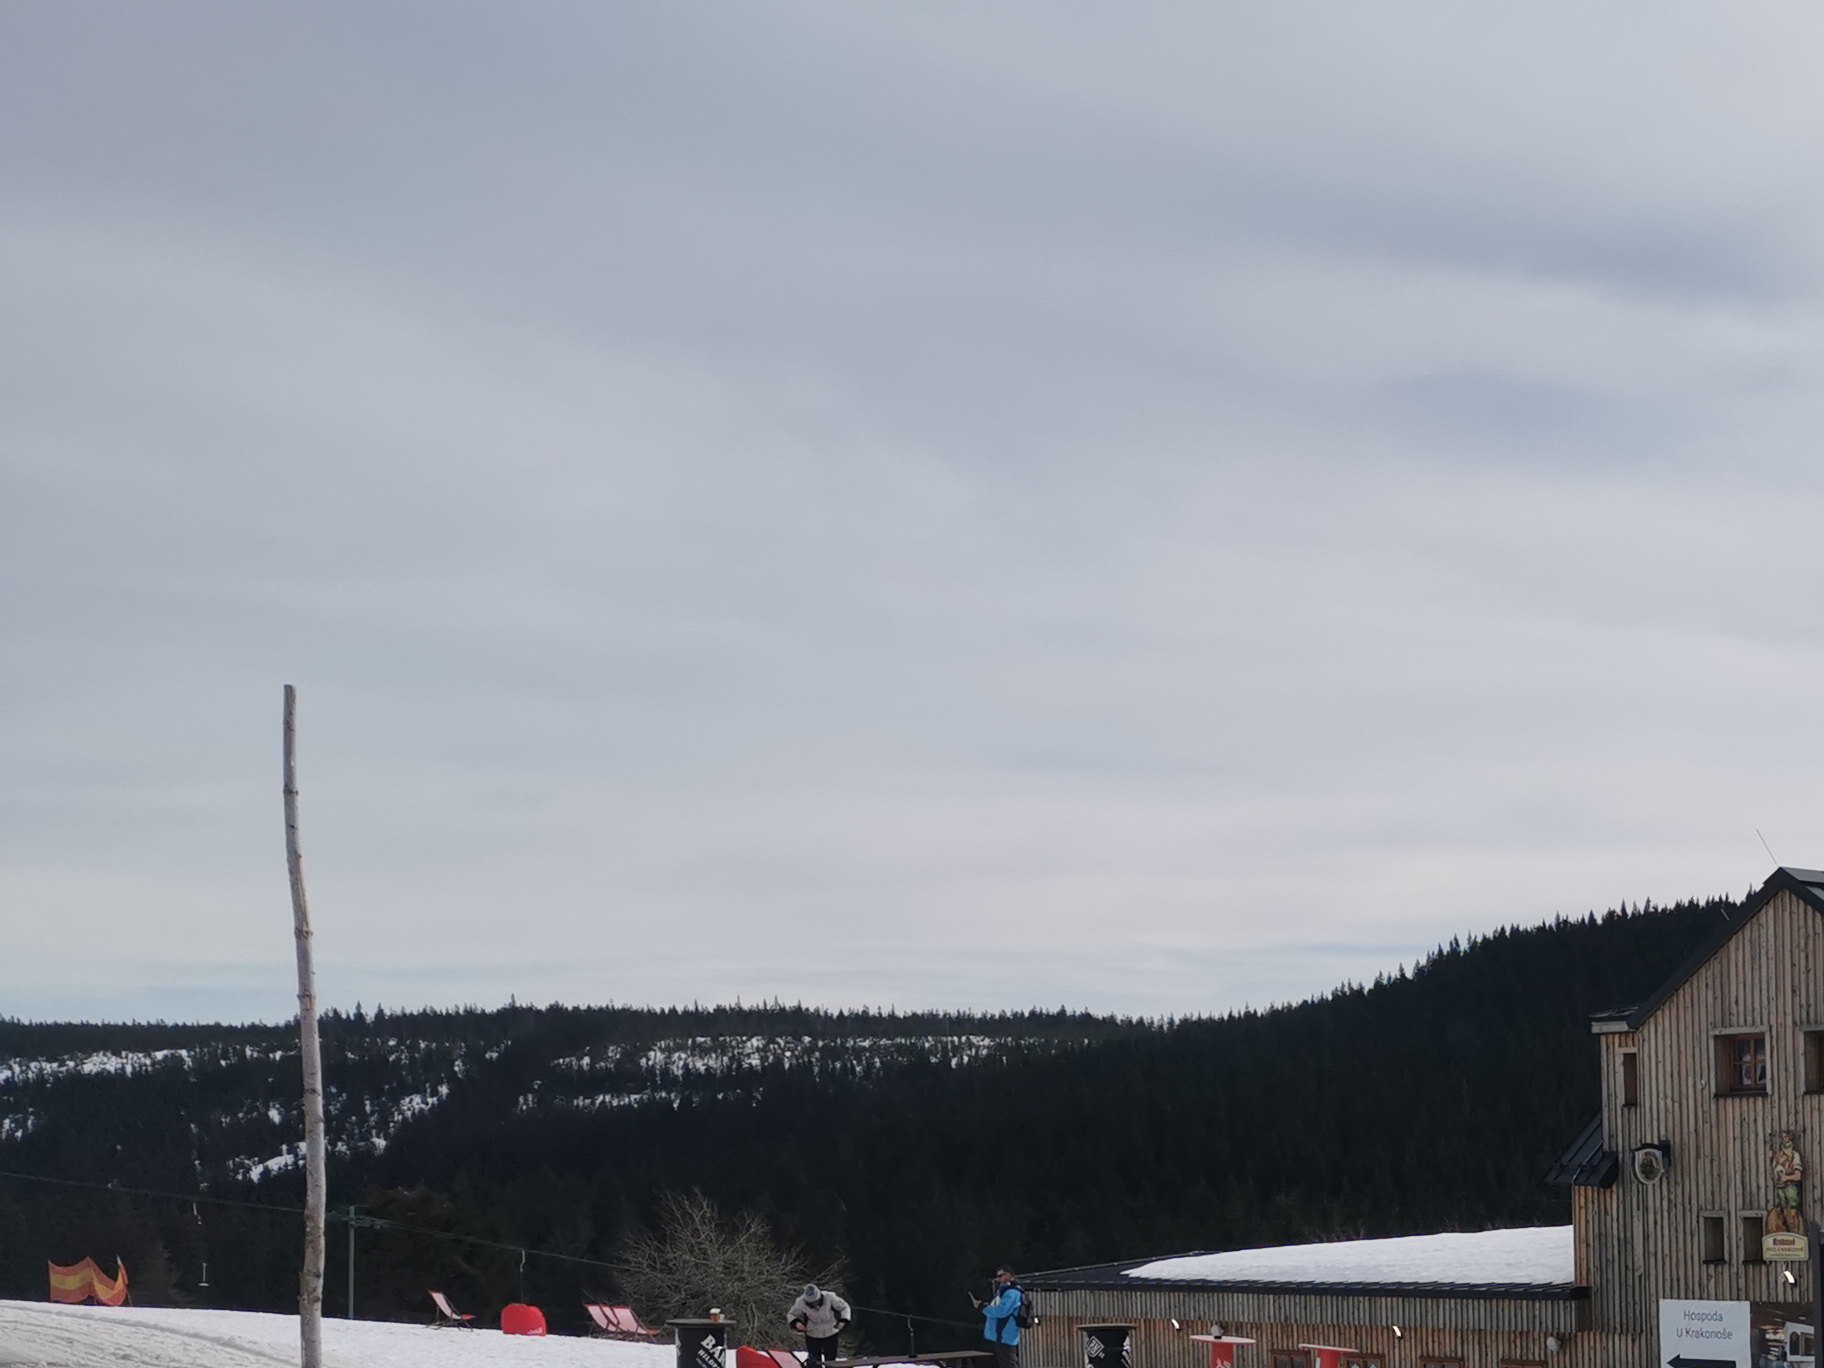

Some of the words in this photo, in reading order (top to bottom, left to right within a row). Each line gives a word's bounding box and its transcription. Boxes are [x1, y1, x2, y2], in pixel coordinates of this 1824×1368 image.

[1683, 1309, 1723, 1324] Hospoda
[1676, 1328, 1683, 1338] U
[1685, 1327, 1733, 1340] Krakonoše
